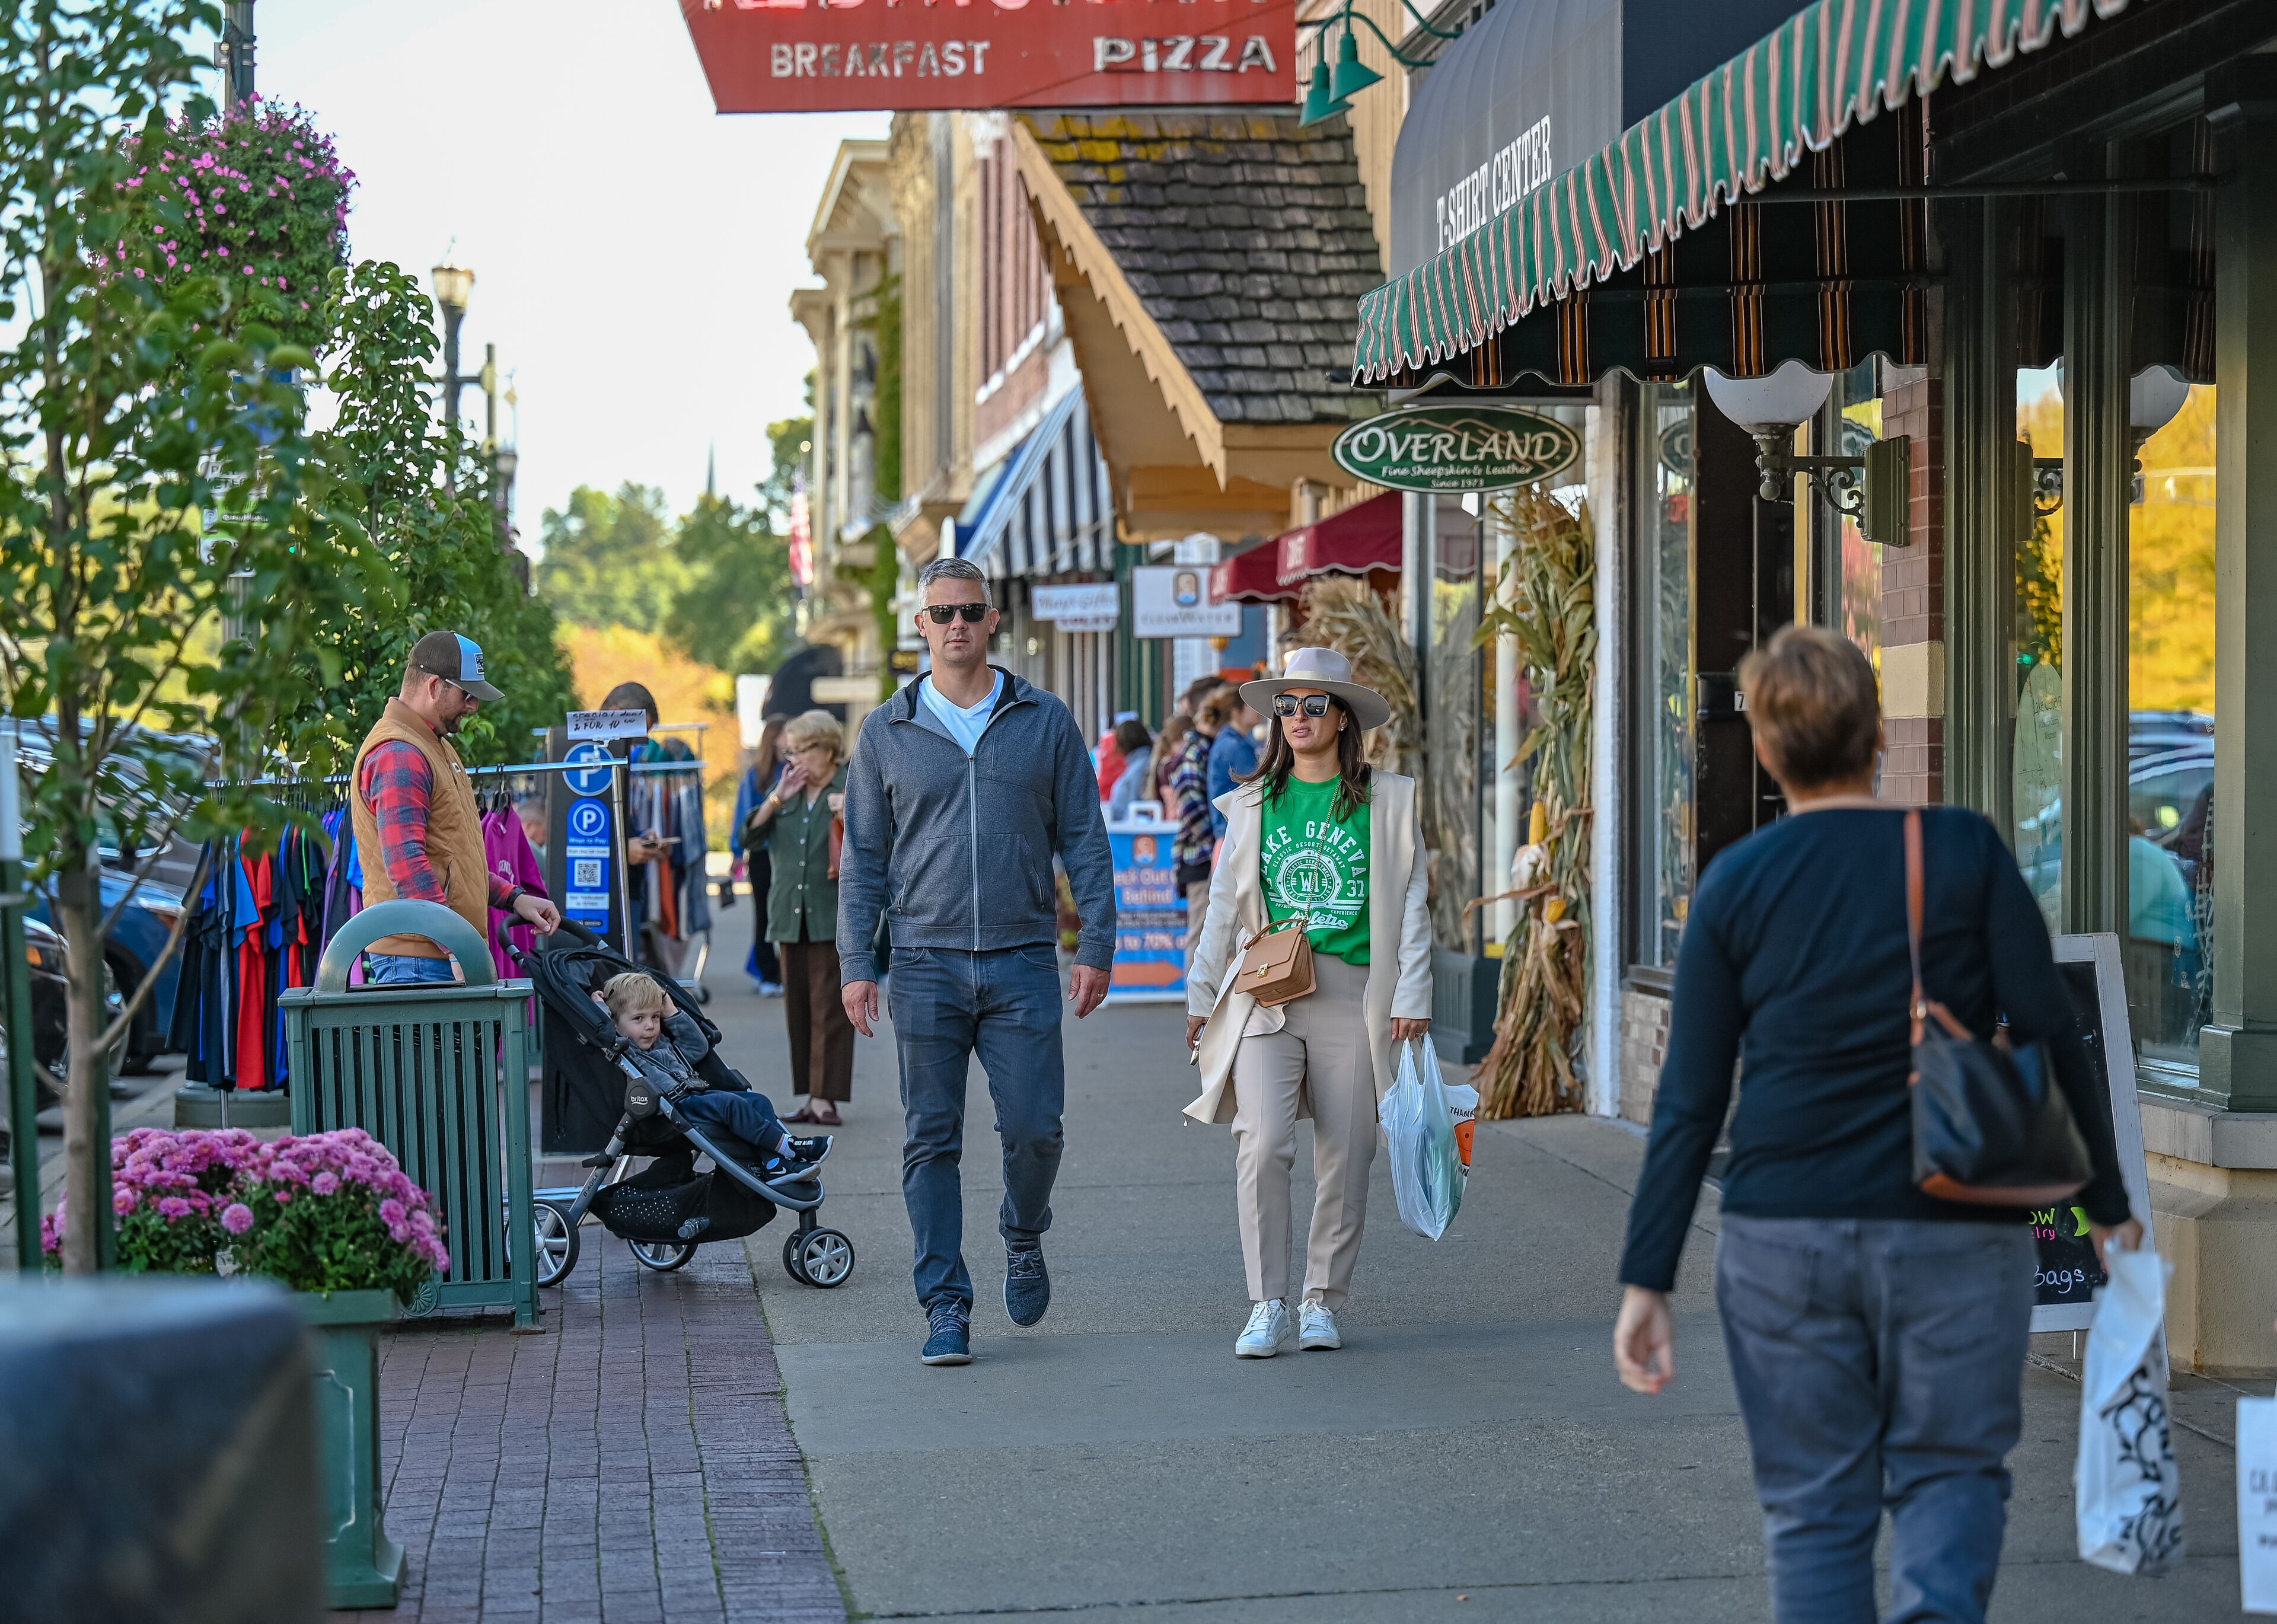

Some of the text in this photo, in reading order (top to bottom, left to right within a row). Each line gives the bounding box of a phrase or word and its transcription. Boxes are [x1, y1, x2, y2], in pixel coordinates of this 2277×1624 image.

[771, 40, 991, 78] BREAKFAST
[1092, 34, 1277, 73] PIZZA
[1436, 114, 1552, 253] T-SHIRT CENTER
[1350, 426, 1561, 464] OVERLAND
[1382, 463, 1534, 478] Fine Sheepskin & Leather
[1431, 479, 1460, 489] Since
[1261, 821, 1366, 878] LAKE GENEVA
[1273, 846, 1292, 867] CLASSIC
[1323, 845, 1345, 868] GETAWAY
[1286, 860, 1303, 879] ATHLETIC
[1347, 879, 1364, 897] 37
